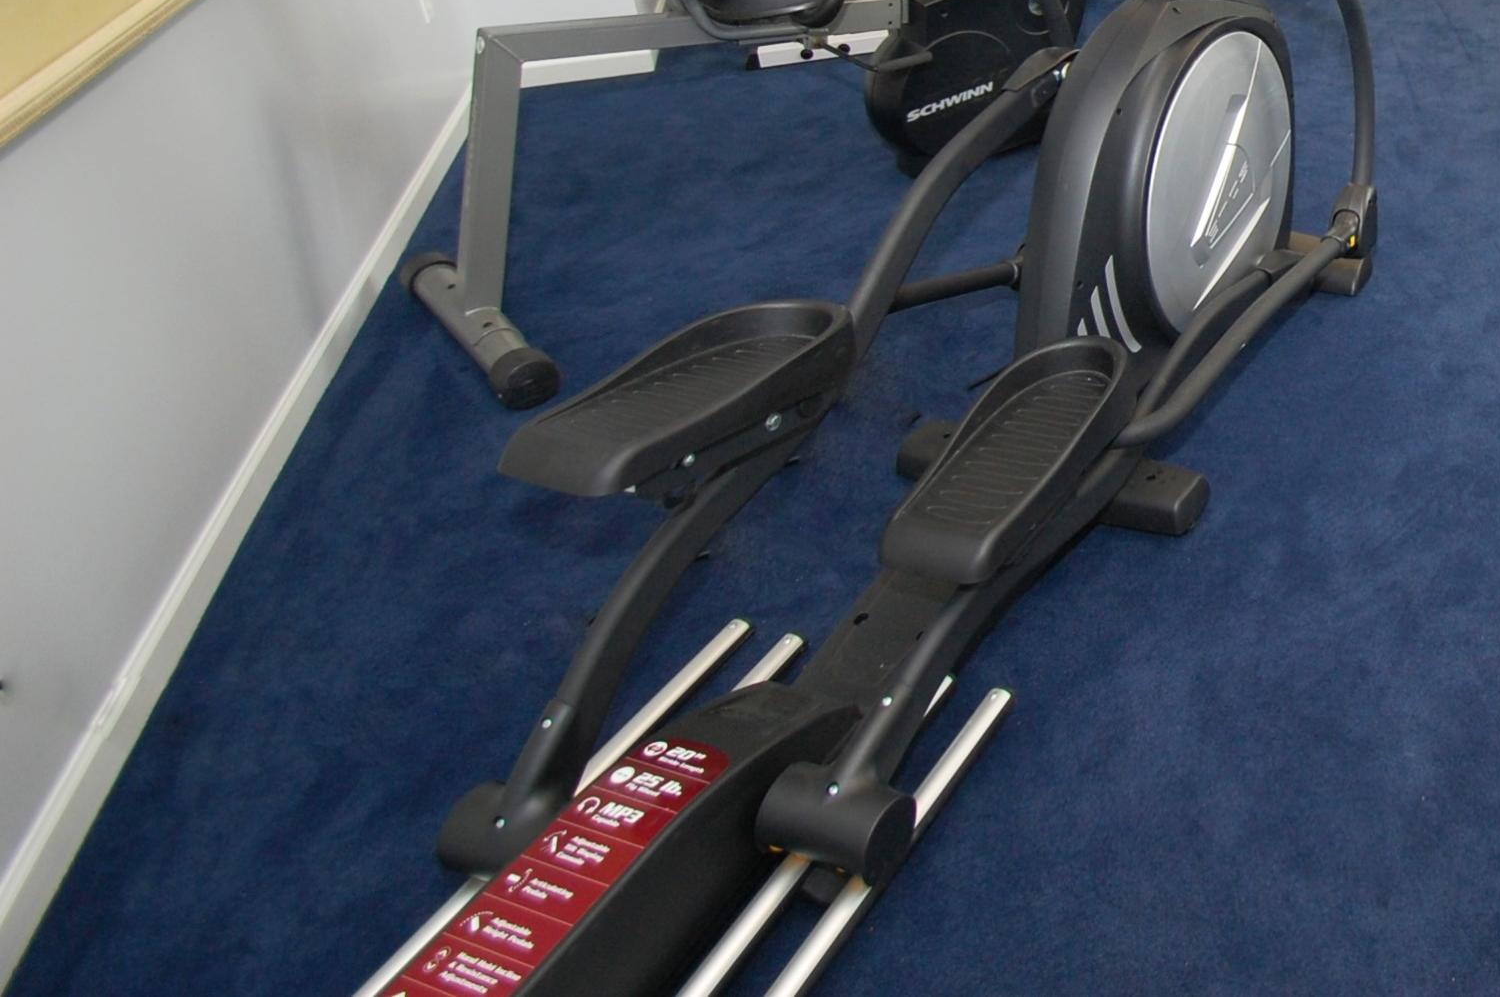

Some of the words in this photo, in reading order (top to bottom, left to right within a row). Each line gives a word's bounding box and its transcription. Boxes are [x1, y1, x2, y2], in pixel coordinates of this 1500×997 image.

[906, 81, 994, 123] SCHWINN
[632, 771, 665, 789] 25
[599, 802, 645, 824] MP3
[490, 916, 533, 937] Adjustable
